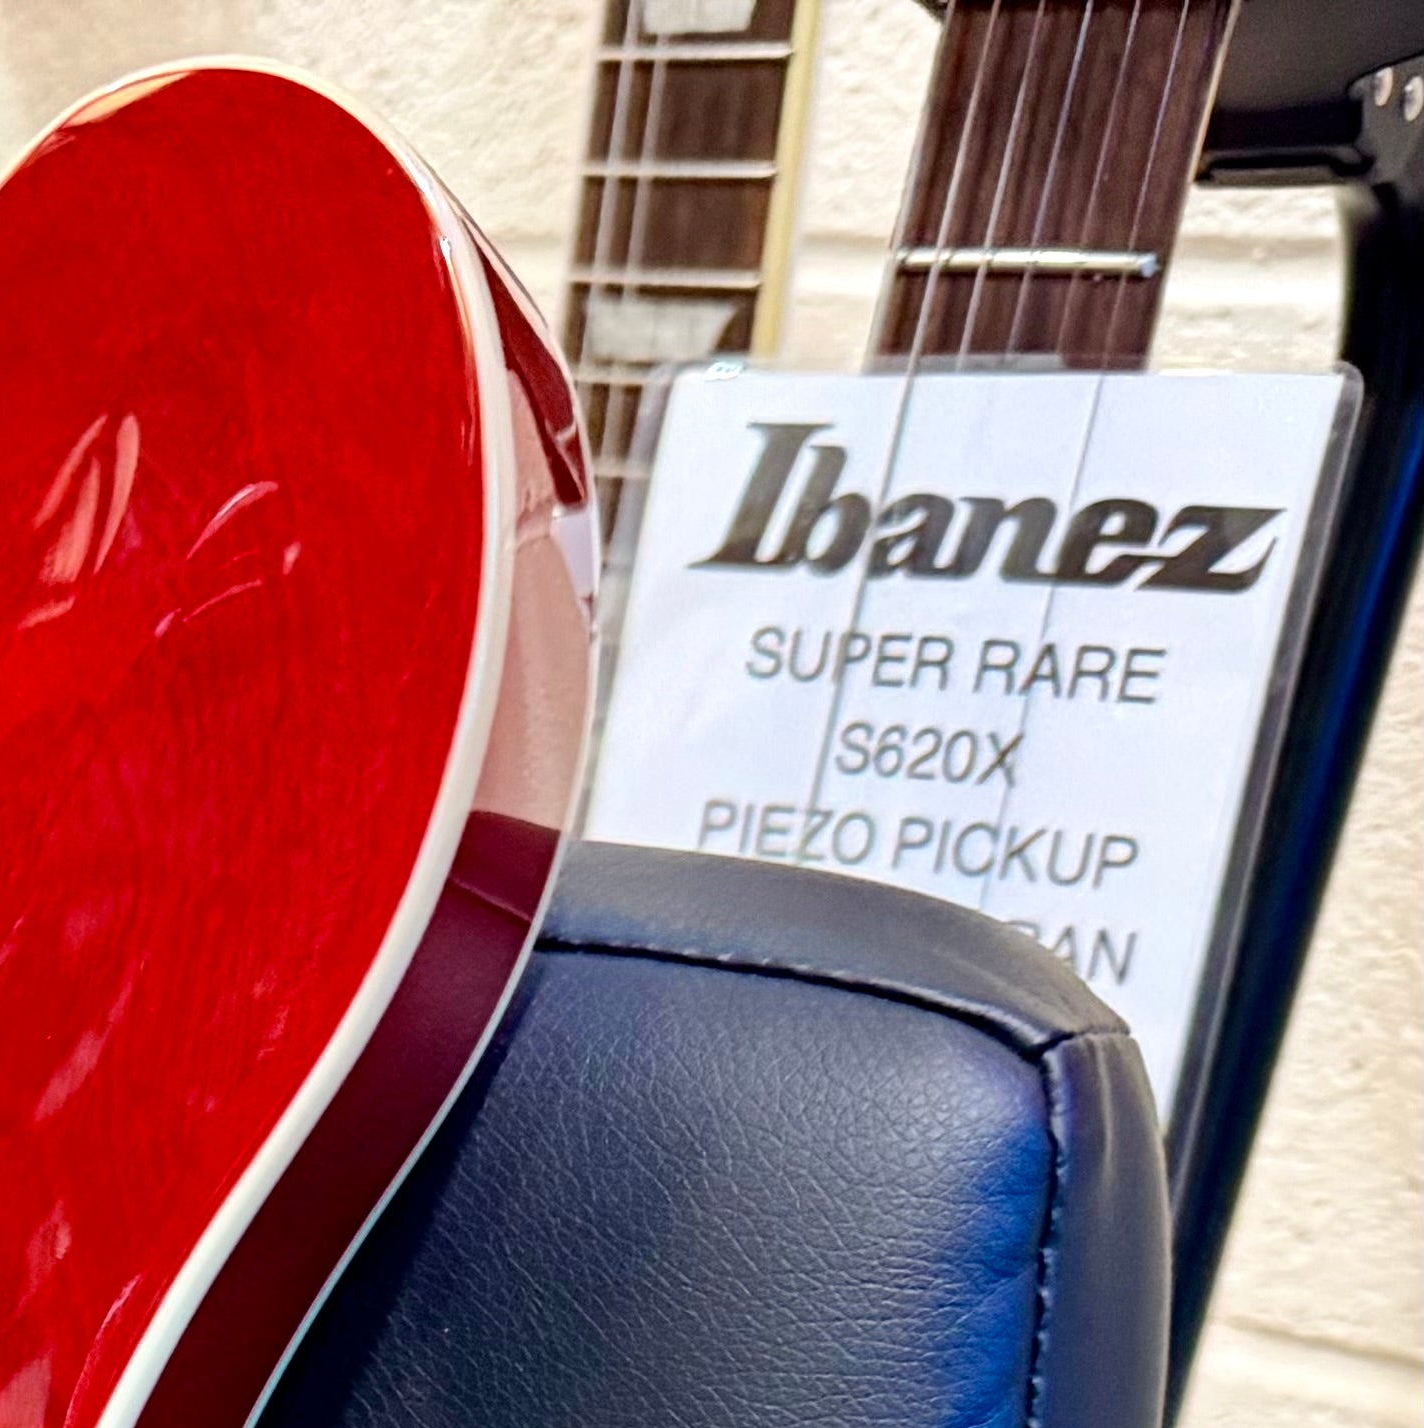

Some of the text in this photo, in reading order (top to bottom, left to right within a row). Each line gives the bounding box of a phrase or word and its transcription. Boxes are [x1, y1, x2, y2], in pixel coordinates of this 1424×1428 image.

[688, 422, 1286, 594] Ibanez
[746, 626, 1167, 704] SUPER RARE
[835, 721, 1025, 788] S620X
[697, 799, 1139, 889] PIEZO PICKUP
[1003, 920, 1138, 986] AN
